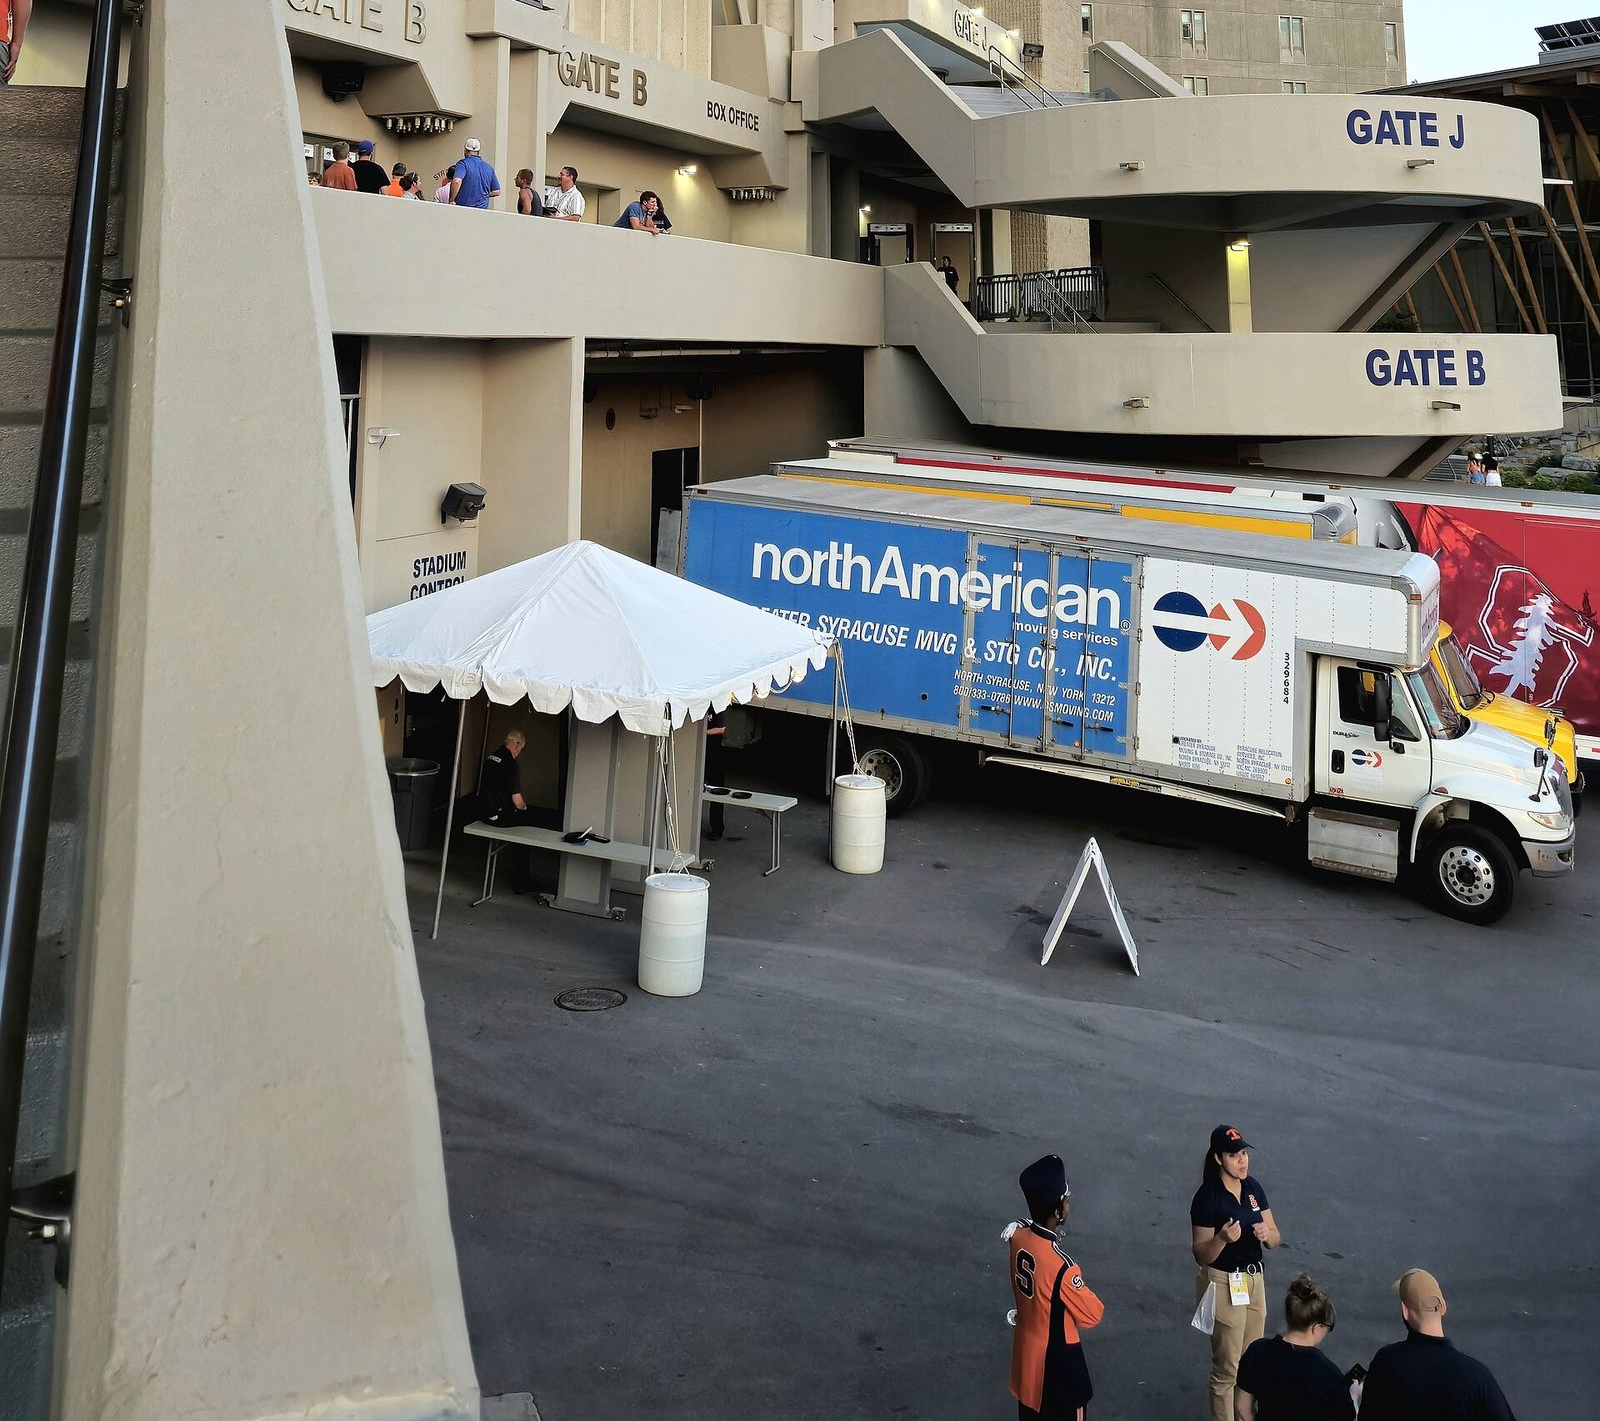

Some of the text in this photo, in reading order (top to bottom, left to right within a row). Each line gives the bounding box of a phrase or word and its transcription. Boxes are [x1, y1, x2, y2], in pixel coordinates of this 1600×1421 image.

[954, 9, 987, 51] GATE J
[557, 45, 648, 106] GATE B
[706, 100, 760, 132] BOX OFFICE
[1346, 108, 1465, 149] GATE J
[1365, 348, 1486, 386] GATE B
[413, 551, 467, 578] STADIUM
[751, 541, 1121, 629] northAmerican
[817, 614, 910, 648] SYRACUSE
[914, 629, 958, 655] MVG
[964, 638, 977, 659] &
[984, 639, 1021, 665] STG
[1076, 654, 1117, 681] INC.
[1062, 628, 1119, 647] services
[954, 669, 984, 683] NORTH
[1062, 687, 1085, 701] YORK
[1091, 692, 1116, 706] 13212
[1015, 1248, 1036, 1300] S
